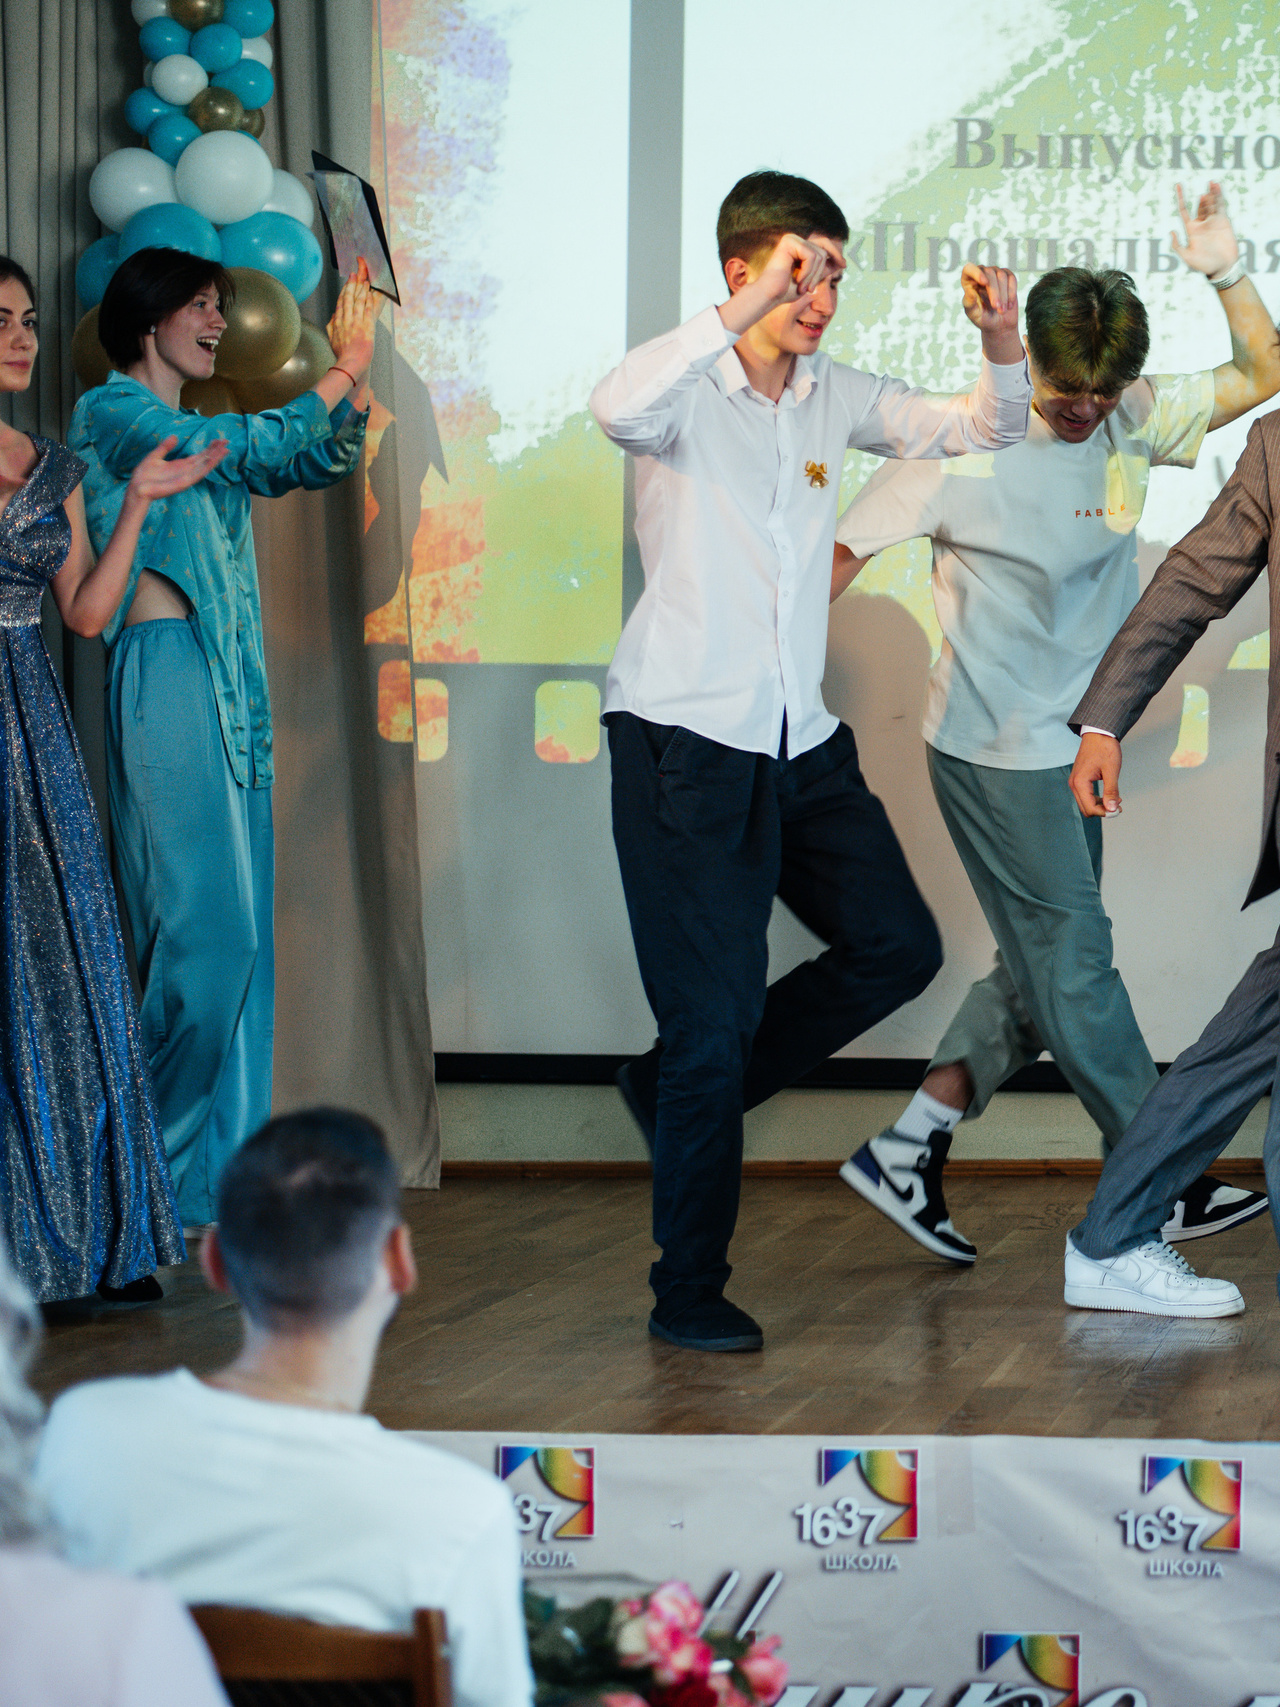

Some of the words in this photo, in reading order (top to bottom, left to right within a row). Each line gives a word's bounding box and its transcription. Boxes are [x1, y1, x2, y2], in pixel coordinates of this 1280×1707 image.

[1075, 503, 1126, 518] FABLE
[794, 1496, 886, 1546] 1637
[1118, 1504, 1209, 1552] 1637
[522, 1549, 578, 1568] КОЛА
[824, 1553, 901, 1571] ШКОЛА
[1148, 1558, 1225, 1577] ШКОЛА
